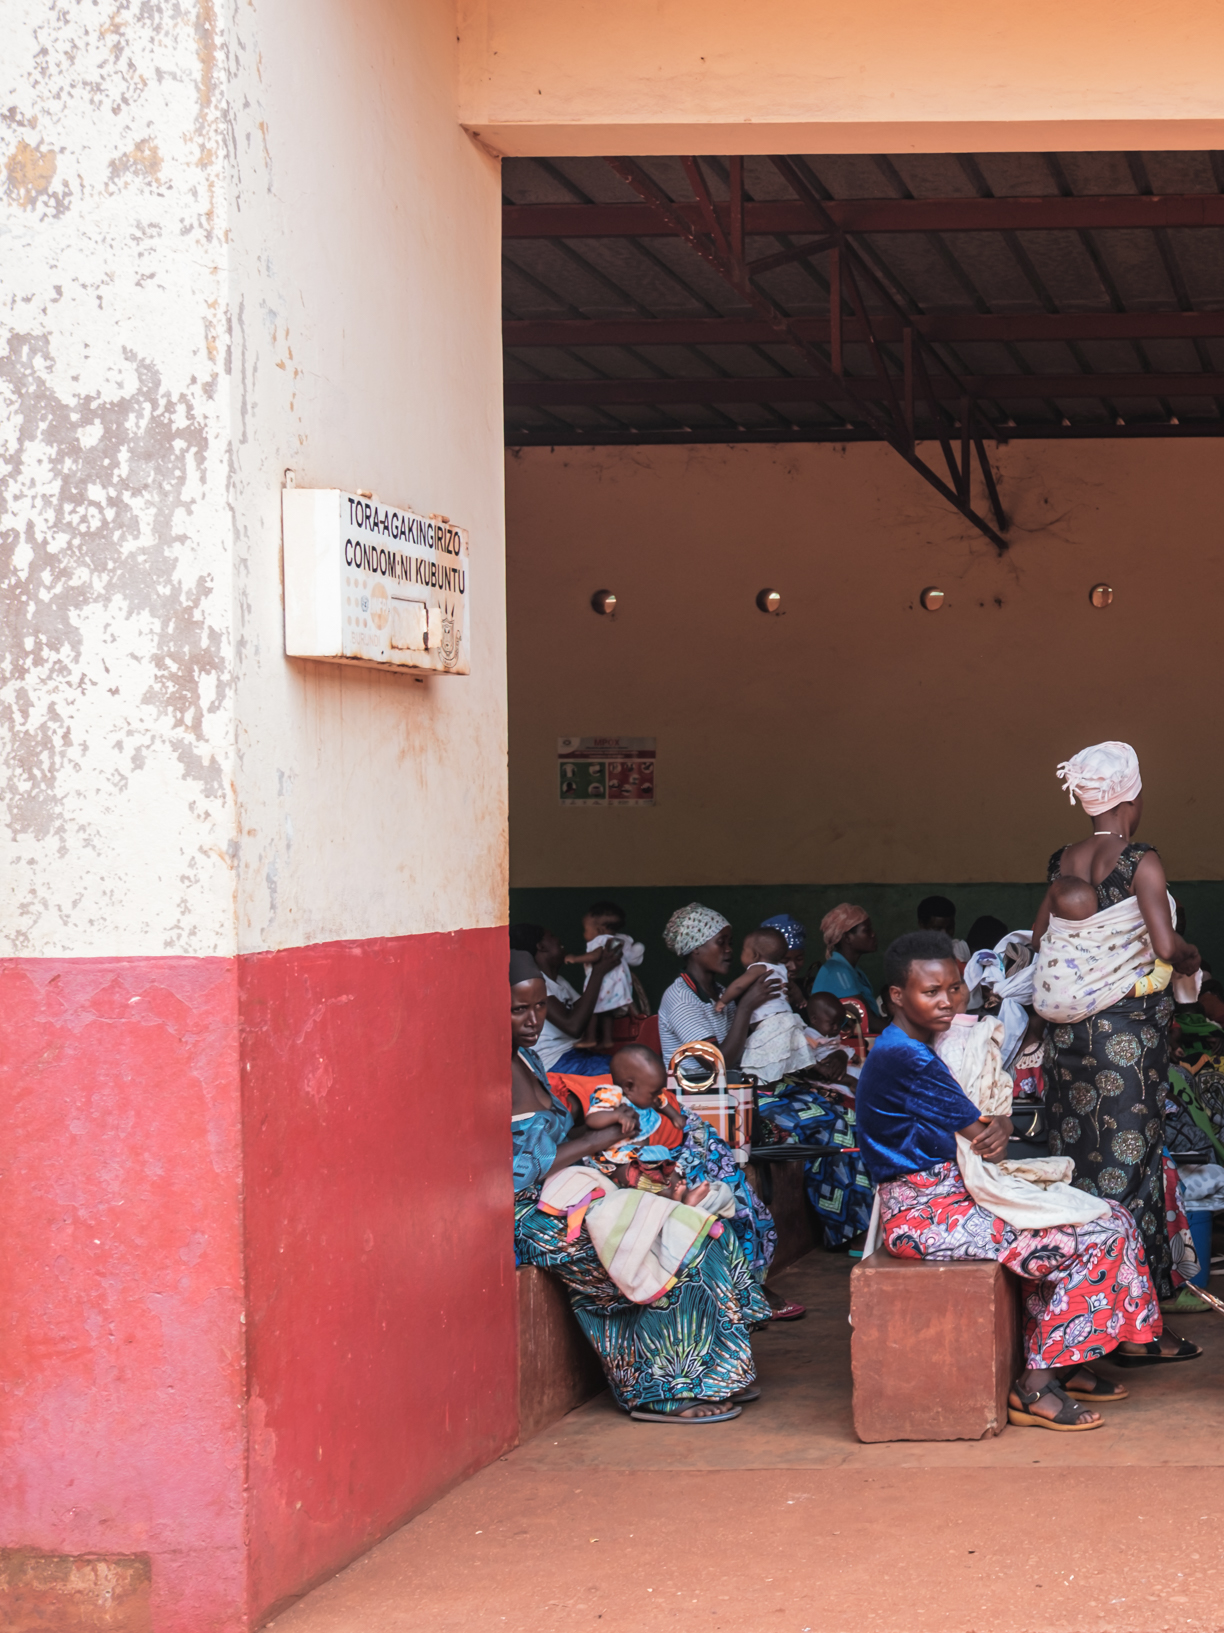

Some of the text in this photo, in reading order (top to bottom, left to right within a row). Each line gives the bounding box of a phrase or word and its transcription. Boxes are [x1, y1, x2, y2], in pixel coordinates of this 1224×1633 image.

[415, 557, 465, 594] KUBUNTU
[351, 631, 381, 647] BURUNDI
[594, 738, 620, 746] MPOX
